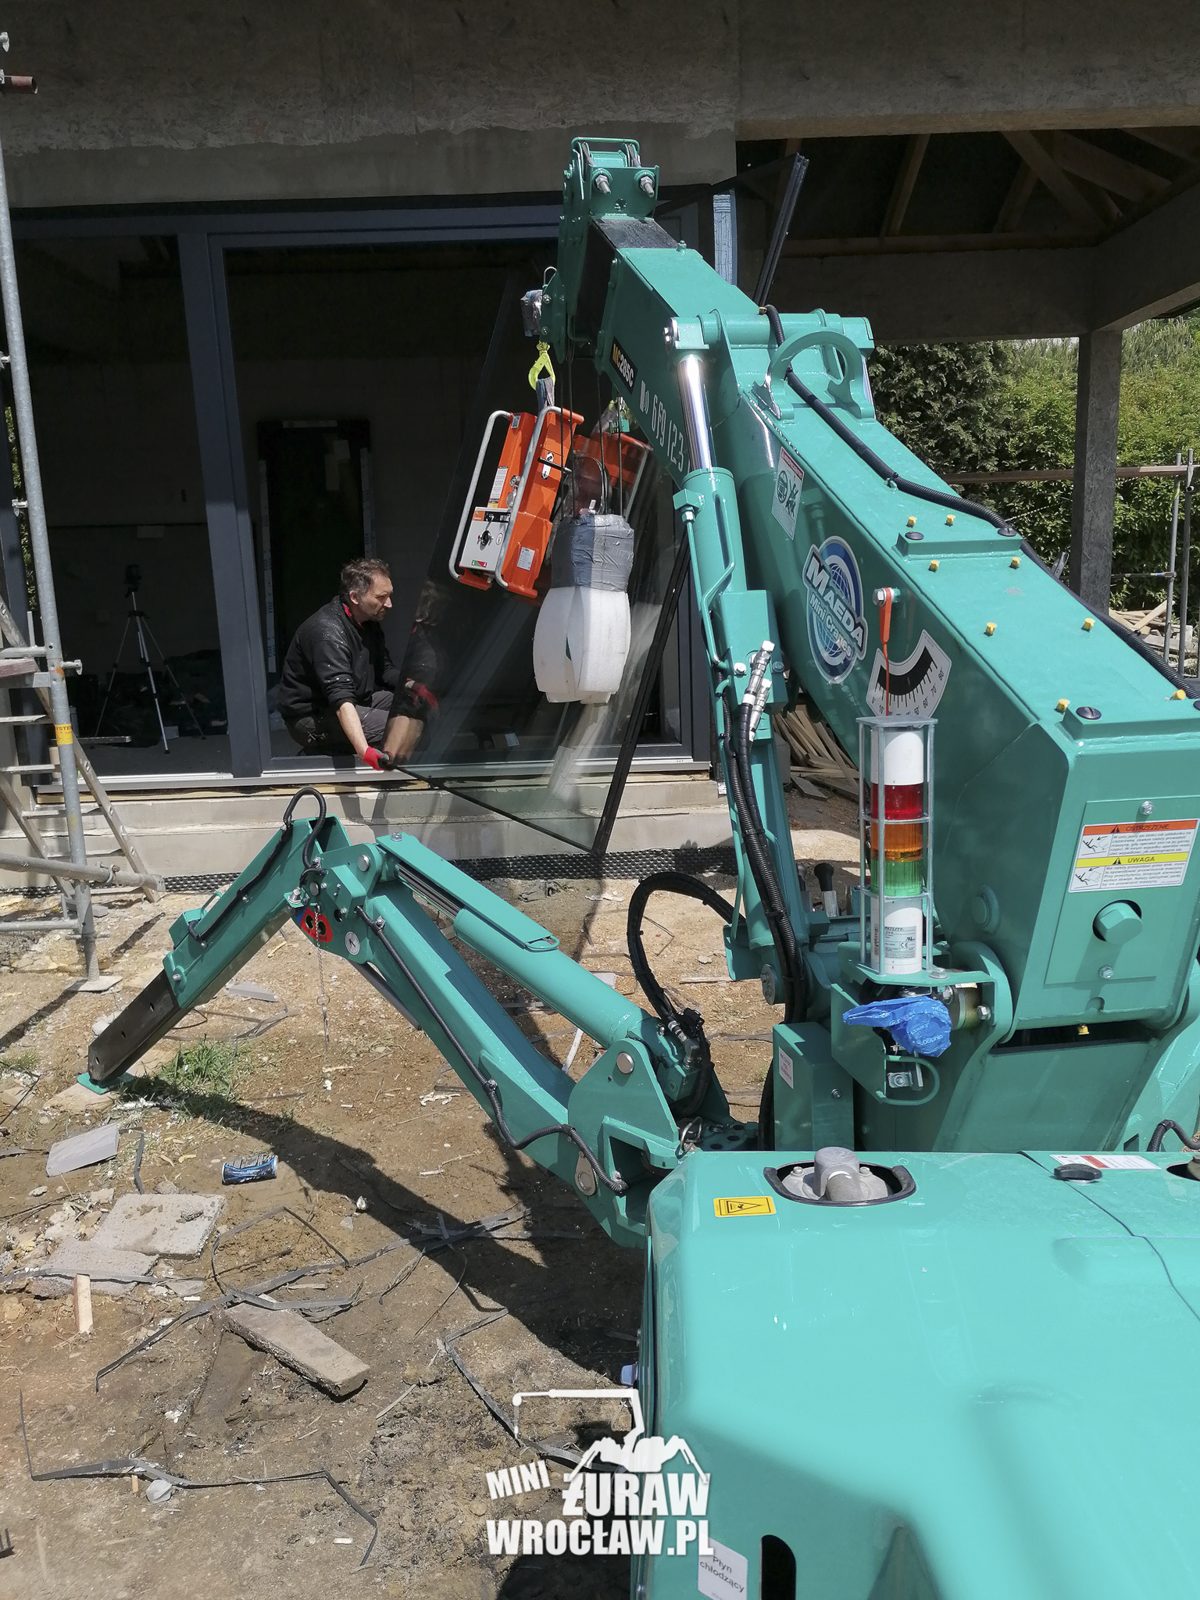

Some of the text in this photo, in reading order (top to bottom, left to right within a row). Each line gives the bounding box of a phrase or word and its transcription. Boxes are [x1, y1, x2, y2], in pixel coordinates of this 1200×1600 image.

[806, 555, 864, 649] MAEDA
[809, 593, 852, 657] Mini Cranes
[1127, 856, 1155, 864] UWAGA
[699, 1561, 745, 1593] chłodzący
[712, 1555, 733, 1574] Płyn
